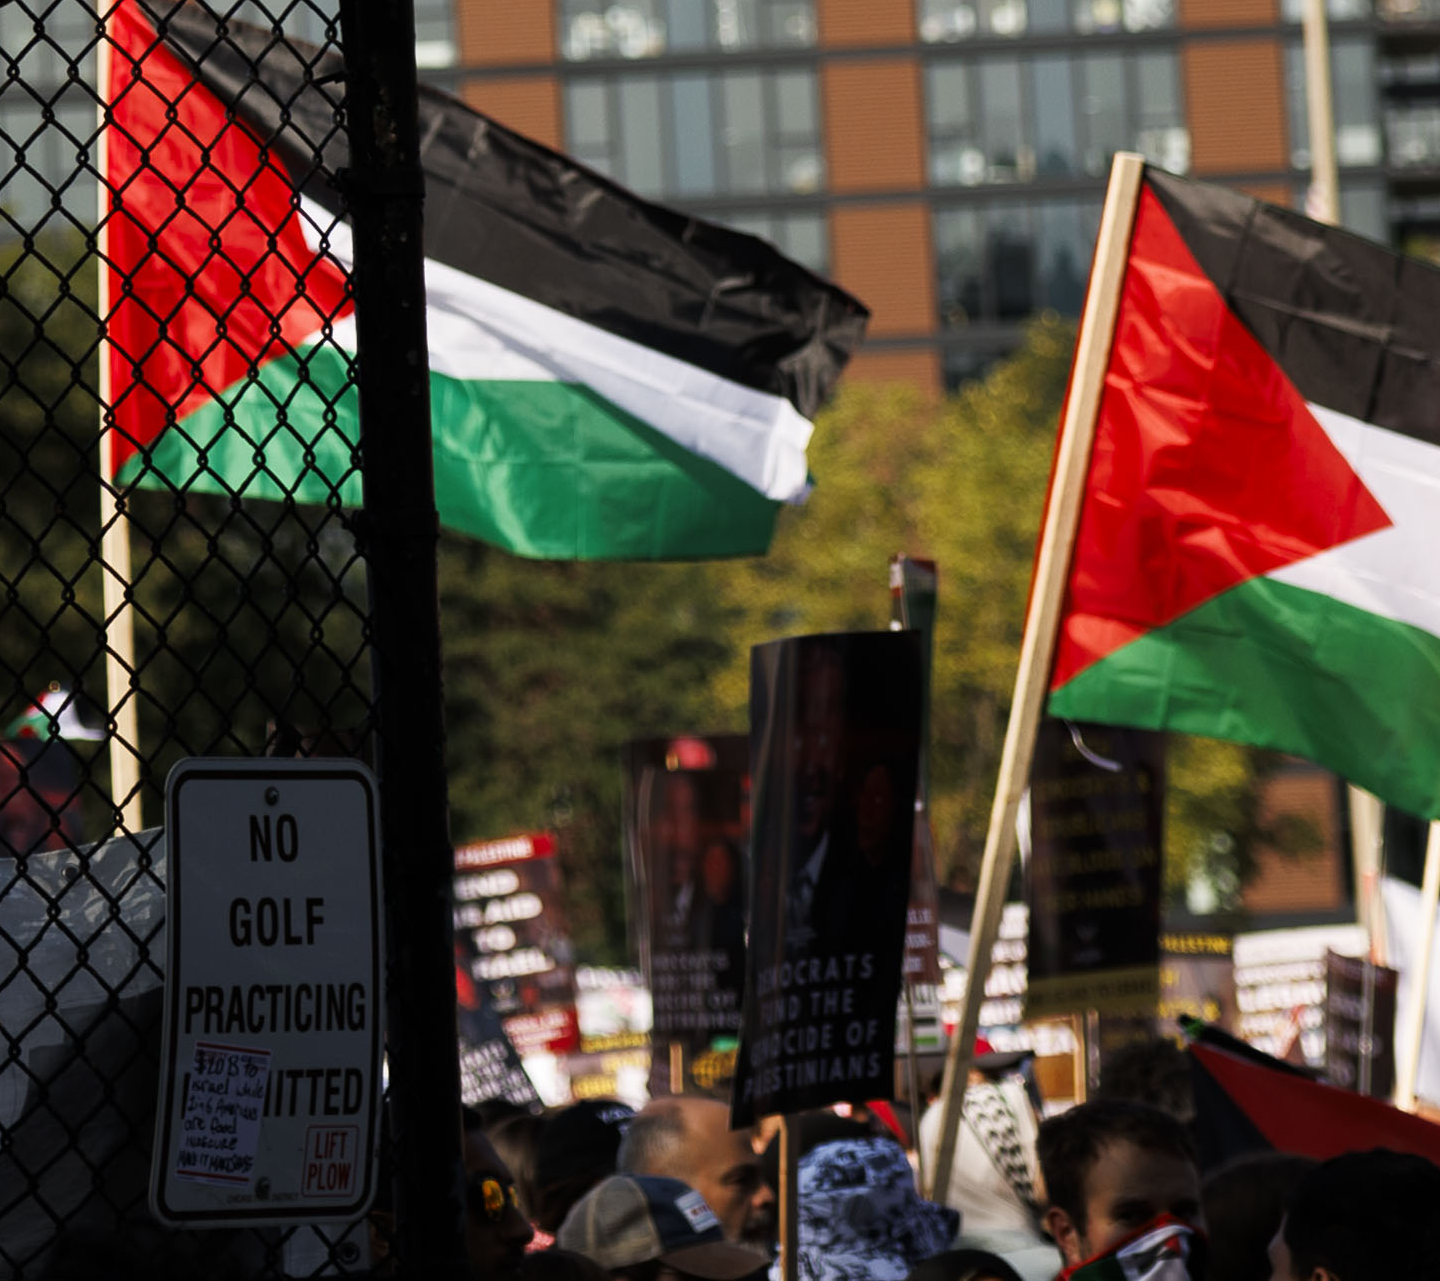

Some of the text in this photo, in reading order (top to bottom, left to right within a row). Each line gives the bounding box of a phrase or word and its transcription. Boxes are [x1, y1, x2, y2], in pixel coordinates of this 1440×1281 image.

[250, 814, 298, 862] NO
[230, 898, 324, 947] GOLF
[185, 983, 365, 1034] PRACTICING
[810, 988, 855, 1016] THE
[845, 1019, 879, 1047] OF
[182, 1068, 363, 1120] ITTED
[314, 1132, 348, 1160] LIFT
[306, 1163, 352, 1190] PLOW
